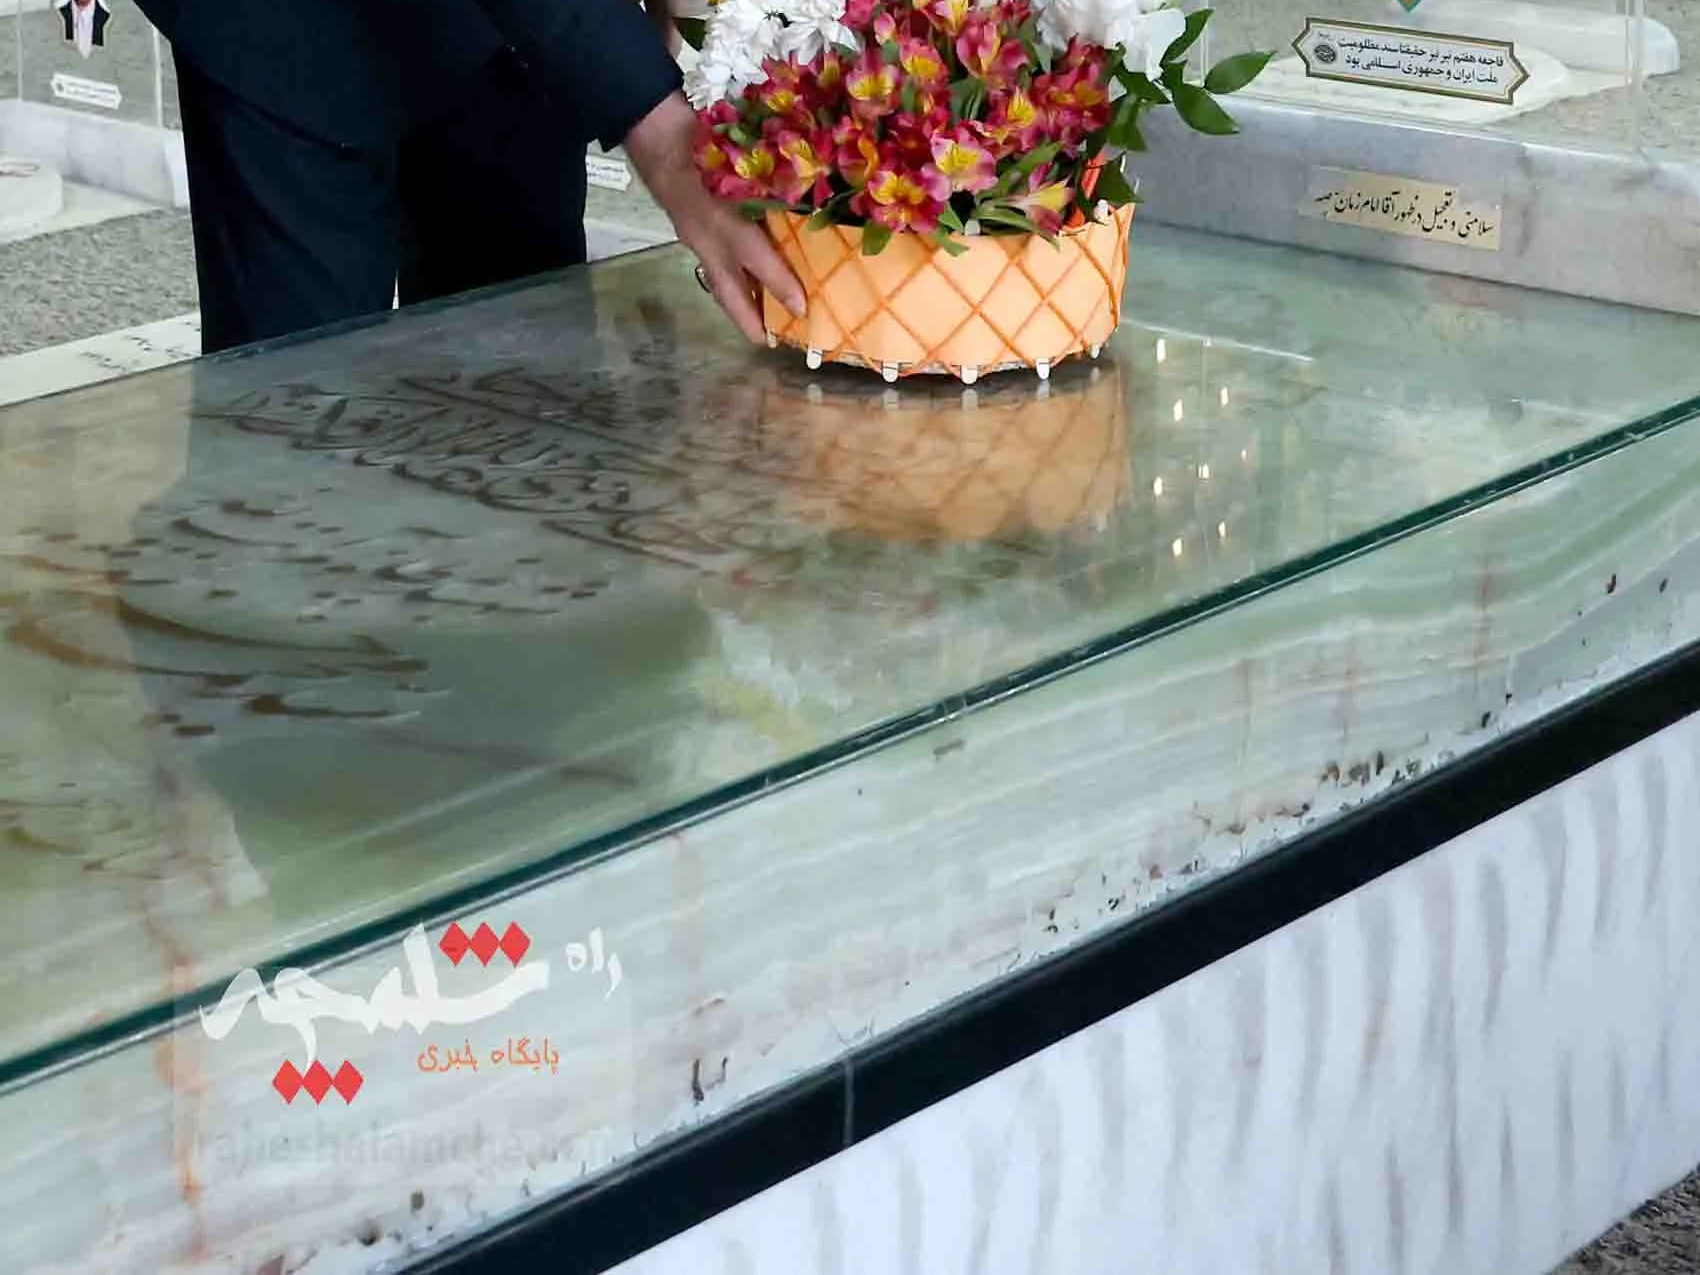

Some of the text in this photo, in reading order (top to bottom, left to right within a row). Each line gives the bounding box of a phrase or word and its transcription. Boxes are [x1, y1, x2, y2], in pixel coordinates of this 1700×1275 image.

[1361, 56, 1401, 71] اسلامی
[1402, 61, 1445, 78] جمهوری
[1453, 68, 1476, 84] ایران
[1334, 192, 1361, 214] زمان
[1361, 197, 1380, 214] امام
[1381, 191, 1401, 215] آقا
[1457, 210, 1494, 238] سلامتی
